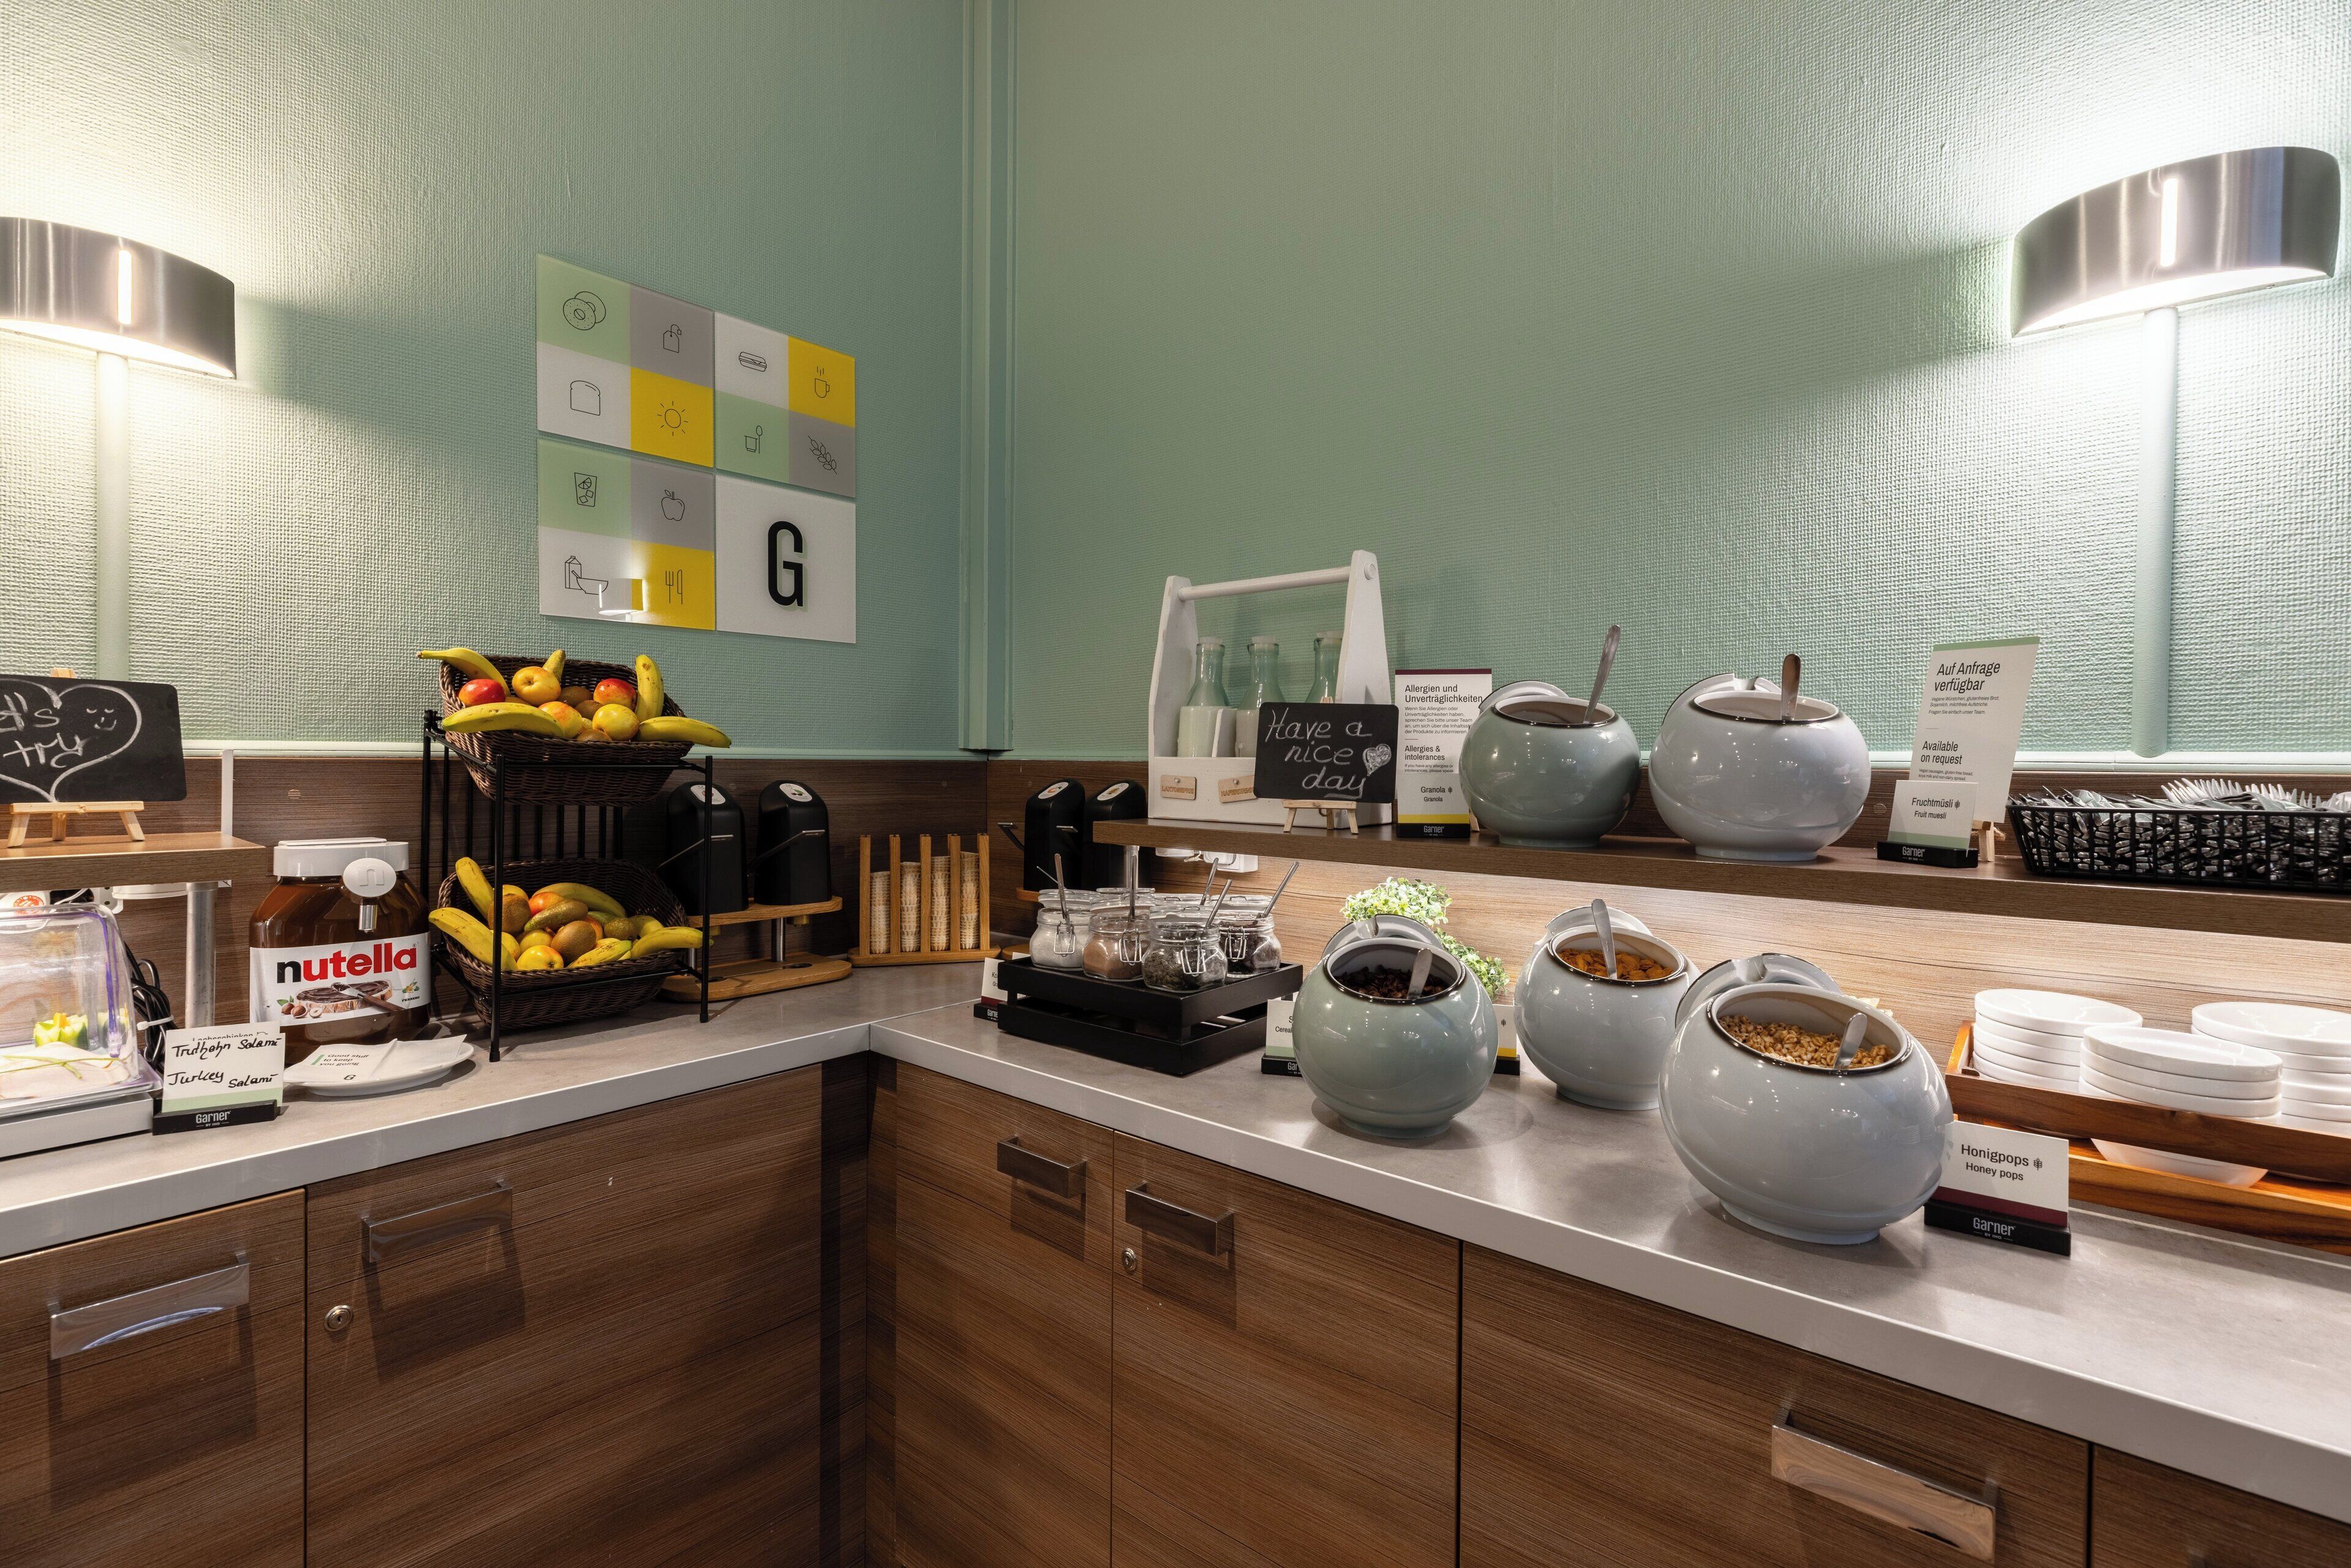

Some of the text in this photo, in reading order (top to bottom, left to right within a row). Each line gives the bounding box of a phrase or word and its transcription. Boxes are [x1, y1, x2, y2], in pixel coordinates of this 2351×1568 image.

[767, 520, 804, 608] G
[1937, 661, 2000, 677] Auf Anfrage
[1404, 685, 1440, 694] Allergien
[1935, 678, 1985, 694] verfügbar
[1404, 694, 1483, 704] Unverträglichkeiten
[1265, 707, 1373, 743] Have a
[2, 732, 86, 768] try
[1284, 740, 1354, 765] nice
[1404, 745, 1433, 754] Allergies
[1922, 740, 1959, 752] Available
[1921, 754, 1962, 766] on request
[1302, 765, 1367, 800] day
[1911, 797, 1953, 808] Fruchtmüsli
[1902, 846, 1925, 857] Garner
[277, 942, 417, 984] nutella
[987, 1008, 998, 1018] Garne
[238, 1037, 282, 1050] Salami
[167, 1070, 279, 1088] Turkey Salami
[196, 1111, 230, 1123] Garner
[1961, 1144, 2029, 1167] Honigpops
[1965, 1161, 2024, 1181] Honey pops
[1973, 1217, 2015, 1237] Garner
